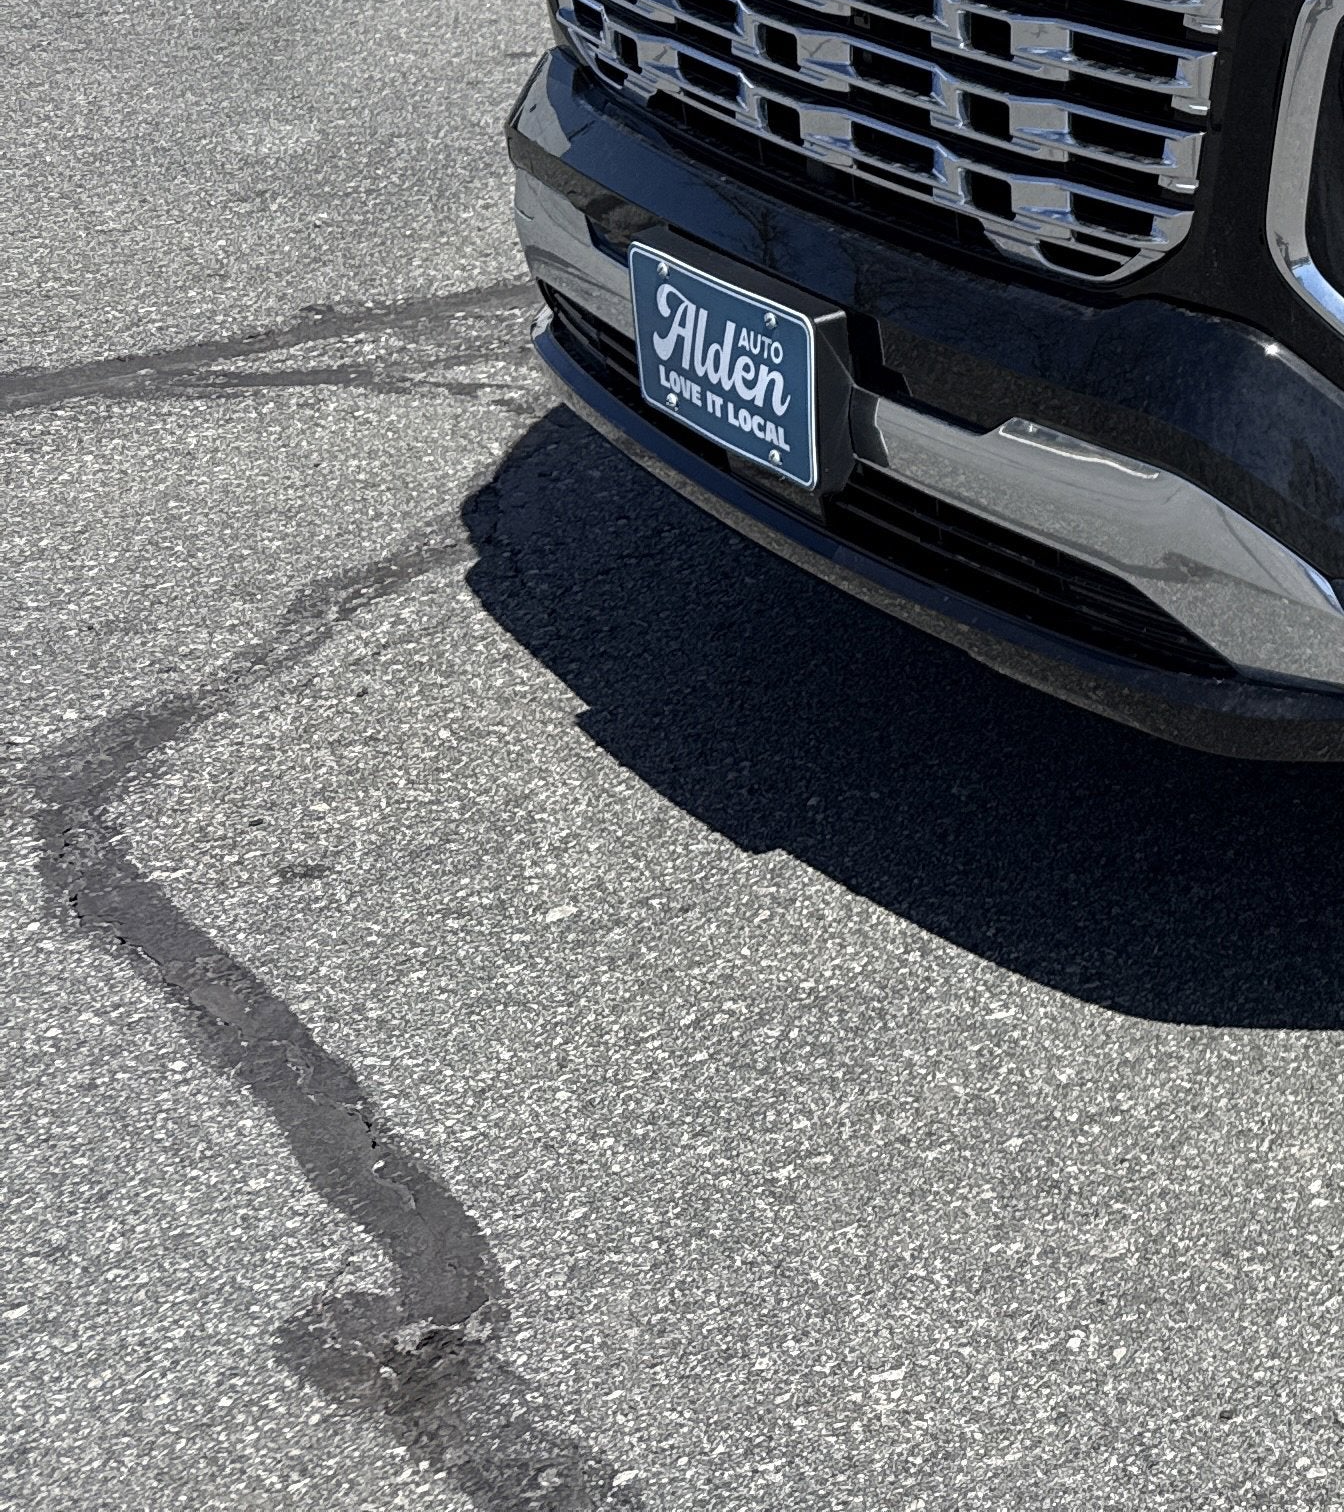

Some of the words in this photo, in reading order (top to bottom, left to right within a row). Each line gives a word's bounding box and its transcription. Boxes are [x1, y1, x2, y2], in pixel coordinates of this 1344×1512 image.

[653, 283, 791, 416] Alden
[738, 327, 784, 364] AUTO
[658, 364, 702, 407] LOVE
[707, 392, 724, 418] IT
[728, 402, 791, 452] LOCAL
